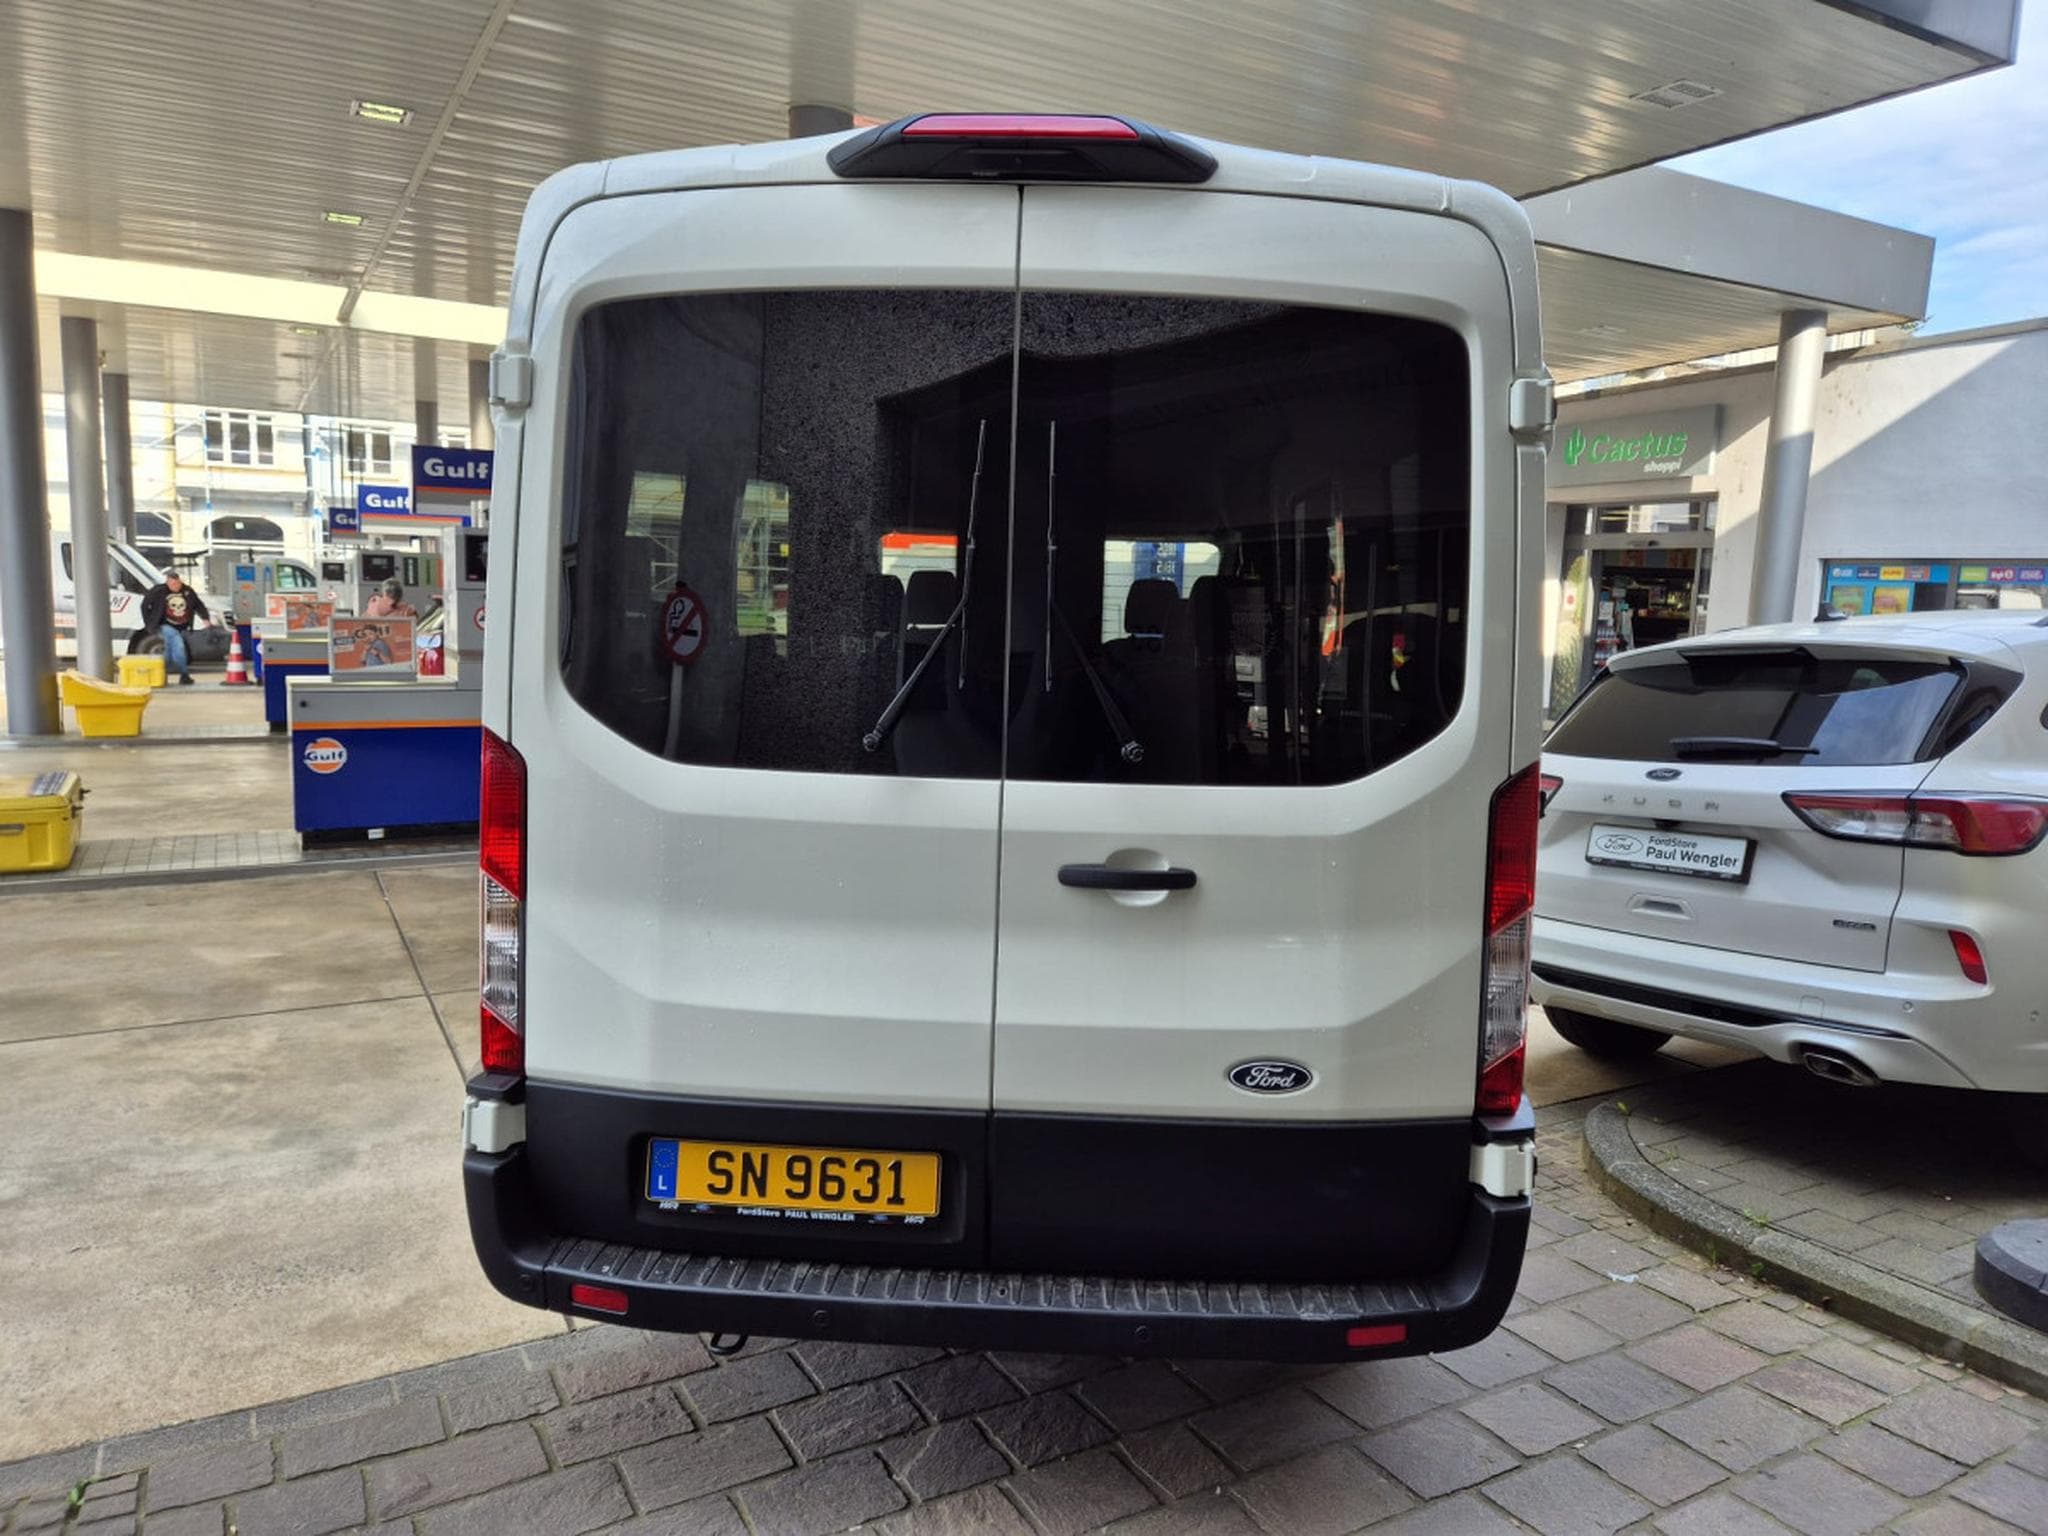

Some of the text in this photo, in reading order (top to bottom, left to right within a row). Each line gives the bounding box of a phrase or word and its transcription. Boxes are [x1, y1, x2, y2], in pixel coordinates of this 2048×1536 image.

[1587, 431, 1688, 464] Cactus
[424, 458, 489, 479] Gulf
[1643, 457, 1682, 474] shoppi
[335, 513, 356, 525] Gu
[306, 751, 344, 761] Gulf
[1648, 835, 1698, 849] FordStore
[1646, 846, 1676, 861] Paul
[1680, 849, 1739, 869] Wengler
[1245, 1066, 1297, 1087] Ford
[658, 1174, 667, 1190] L
[707, 1150, 905, 1206] SN 9631
[785, 1209, 808, 1220] PAUL
